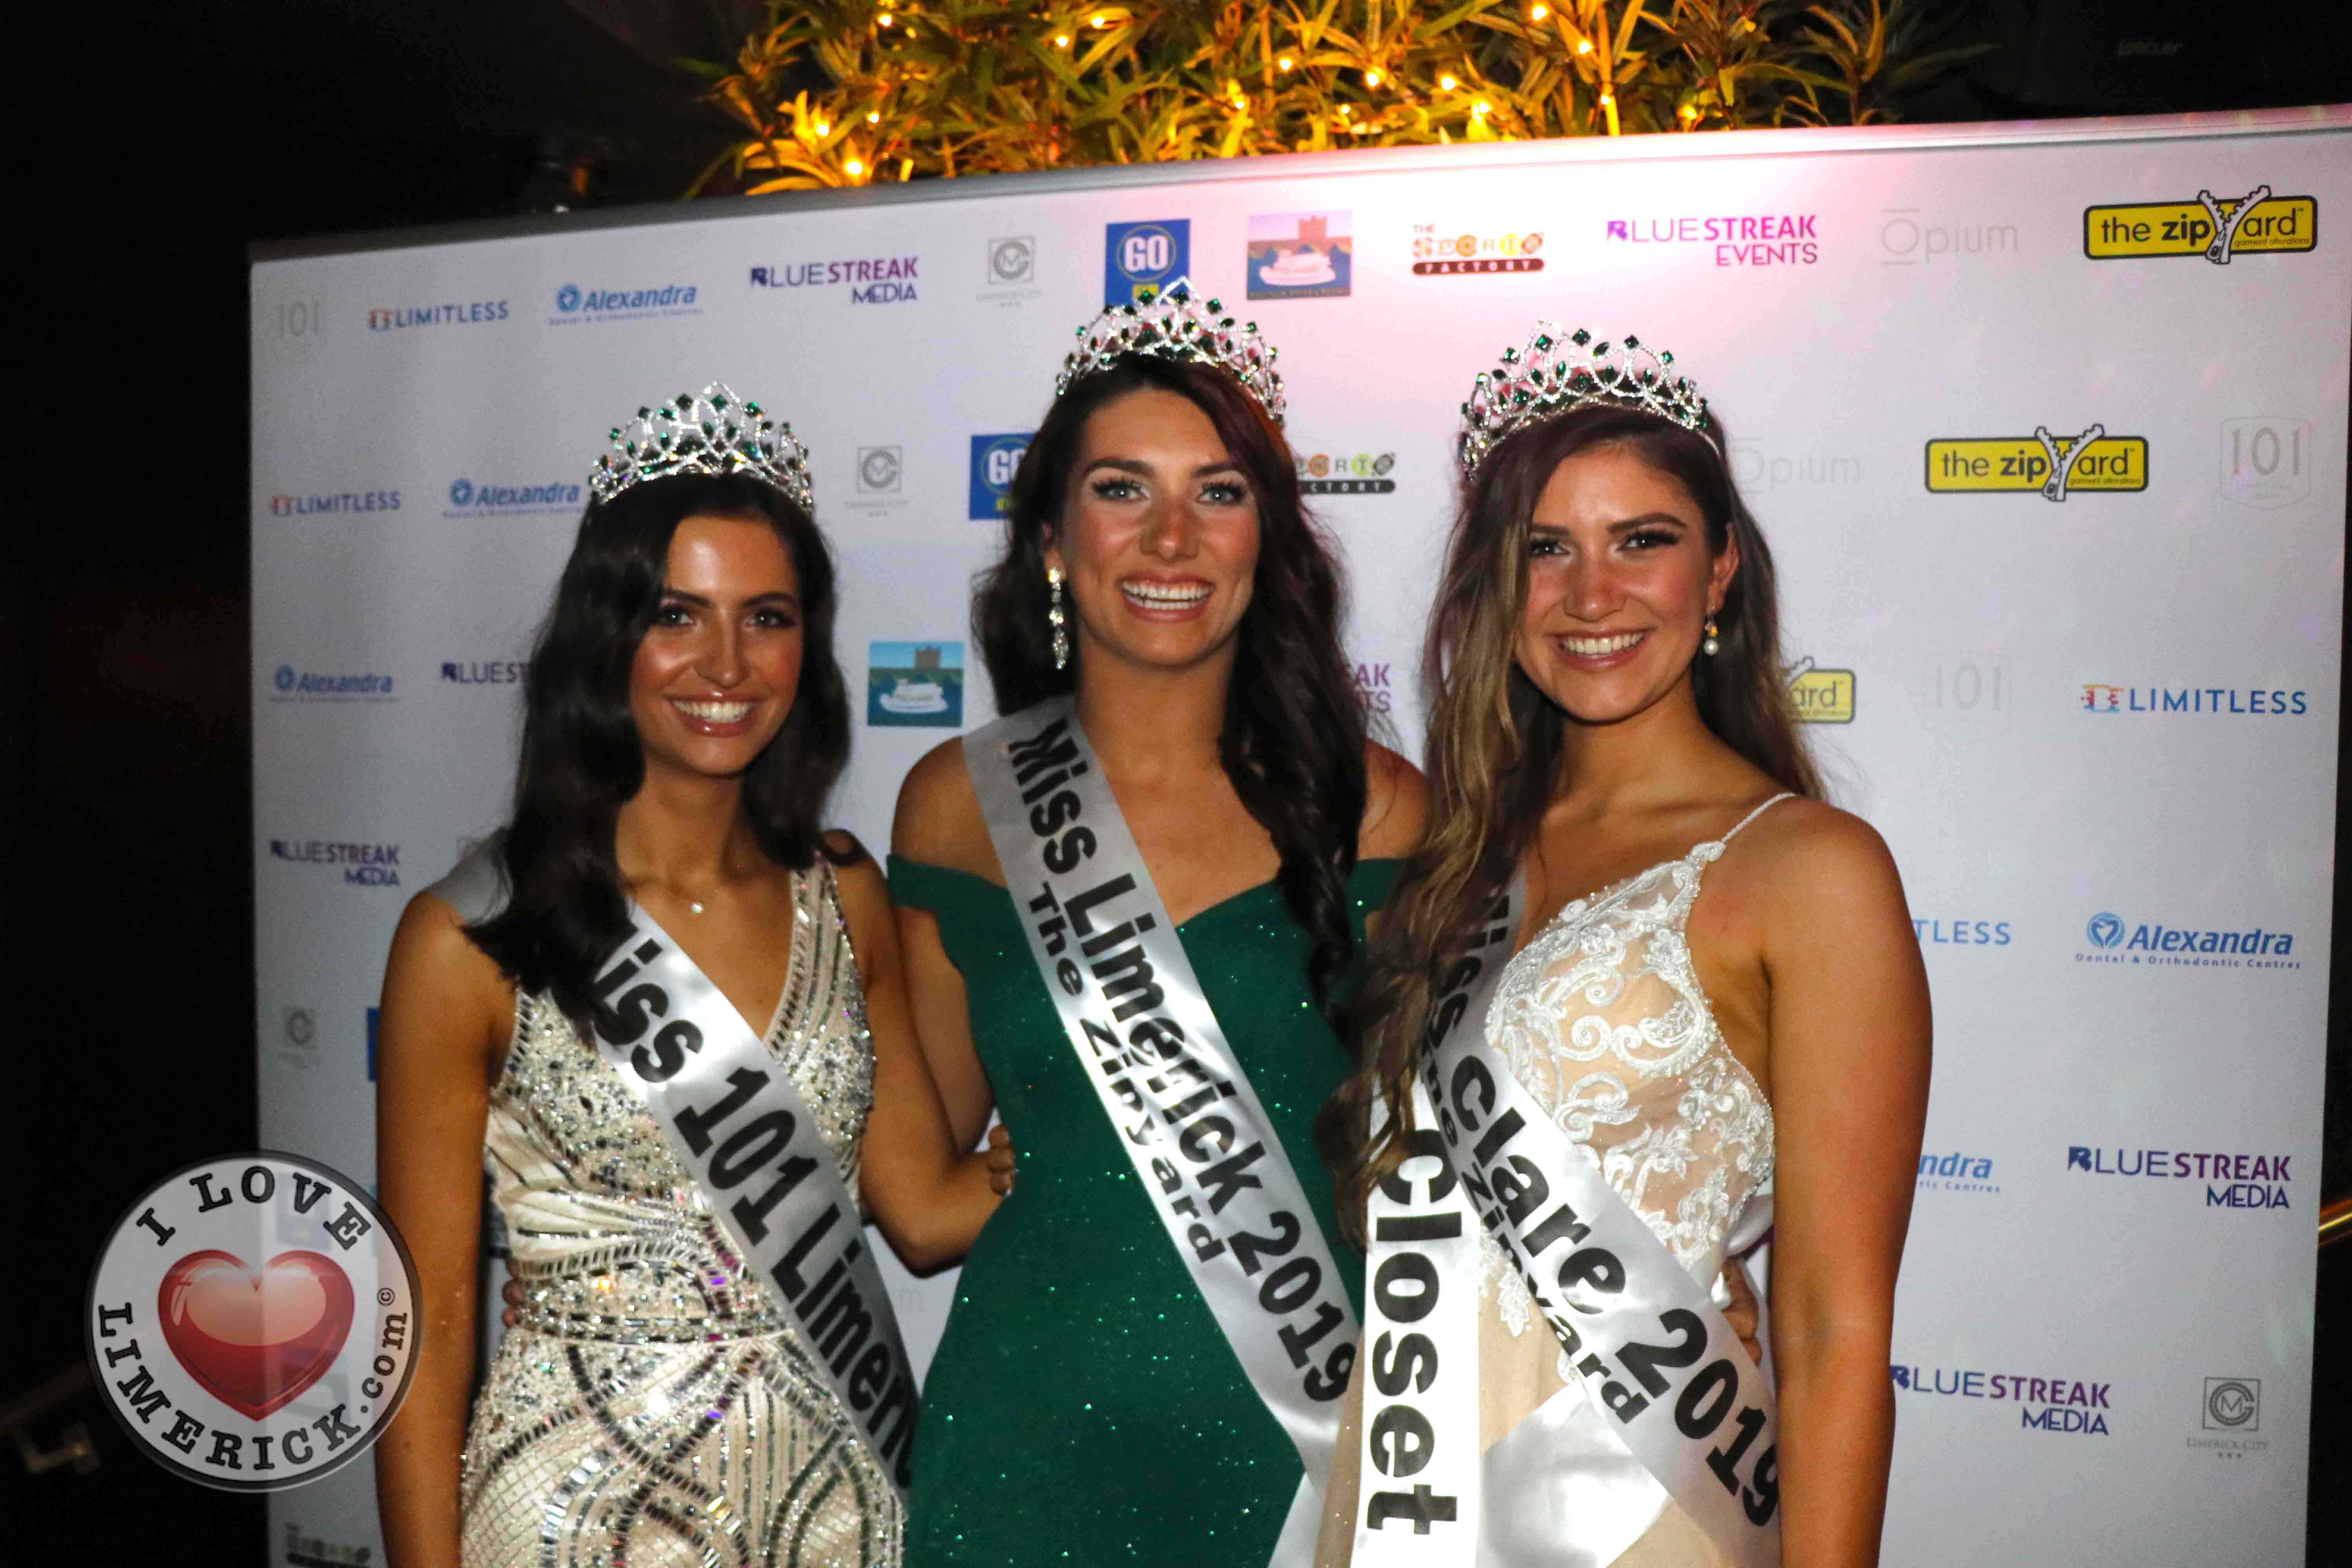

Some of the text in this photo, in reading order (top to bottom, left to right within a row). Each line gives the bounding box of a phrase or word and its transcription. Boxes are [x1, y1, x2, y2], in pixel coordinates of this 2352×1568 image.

[2101, 217, 2150, 243] the
[1125, 235, 1168, 272] GO
[1425, 260, 1530, 274] FACTORY
[1717, 243, 1817, 266] EVENTS
[583, 285, 697, 311] Alexandra
[852, 282, 917, 304] MEDIA
[396, 301, 509, 328] LIMITLESS
[1942, 451, 1989, 477] the
[2232, 426, 2300, 476] 101
[296, 491, 401, 515] LIMITLESS
[477, 482, 581, 506] Alexandra
[296, 672, 393, 694] Alexandra
[2130, 688, 2307, 715] LIMITLESS
[345, 867, 400, 886] MEDIA
[2127, 924, 2294, 955] Alexandra
[2075, 953, 2301, 969] Dental & Orthodontic Centres
[591, 923, 703, 1083] iss
[673, 1066, 819, 1247] 101
[1029, 880, 1226, 1263] The Zipyard
[1064, 873, 1266, 1216] Limerick
[1228, 1210, 1357, 1402] 2019
[2068, 1146, 2291, 1181] BLUESTREAK
[2207, 1185, 2290, 1209] MEDIA
[1451, 1055, 1626, 1315] Clare
[1614, 1308, 1779, 1527] 2019
[1367, 1129, 1462, 1535] Closet
[1890, 1365, 2111, 1408] BLUESTREAK
[2022, 1408, 2109, 1436] MEDIA
